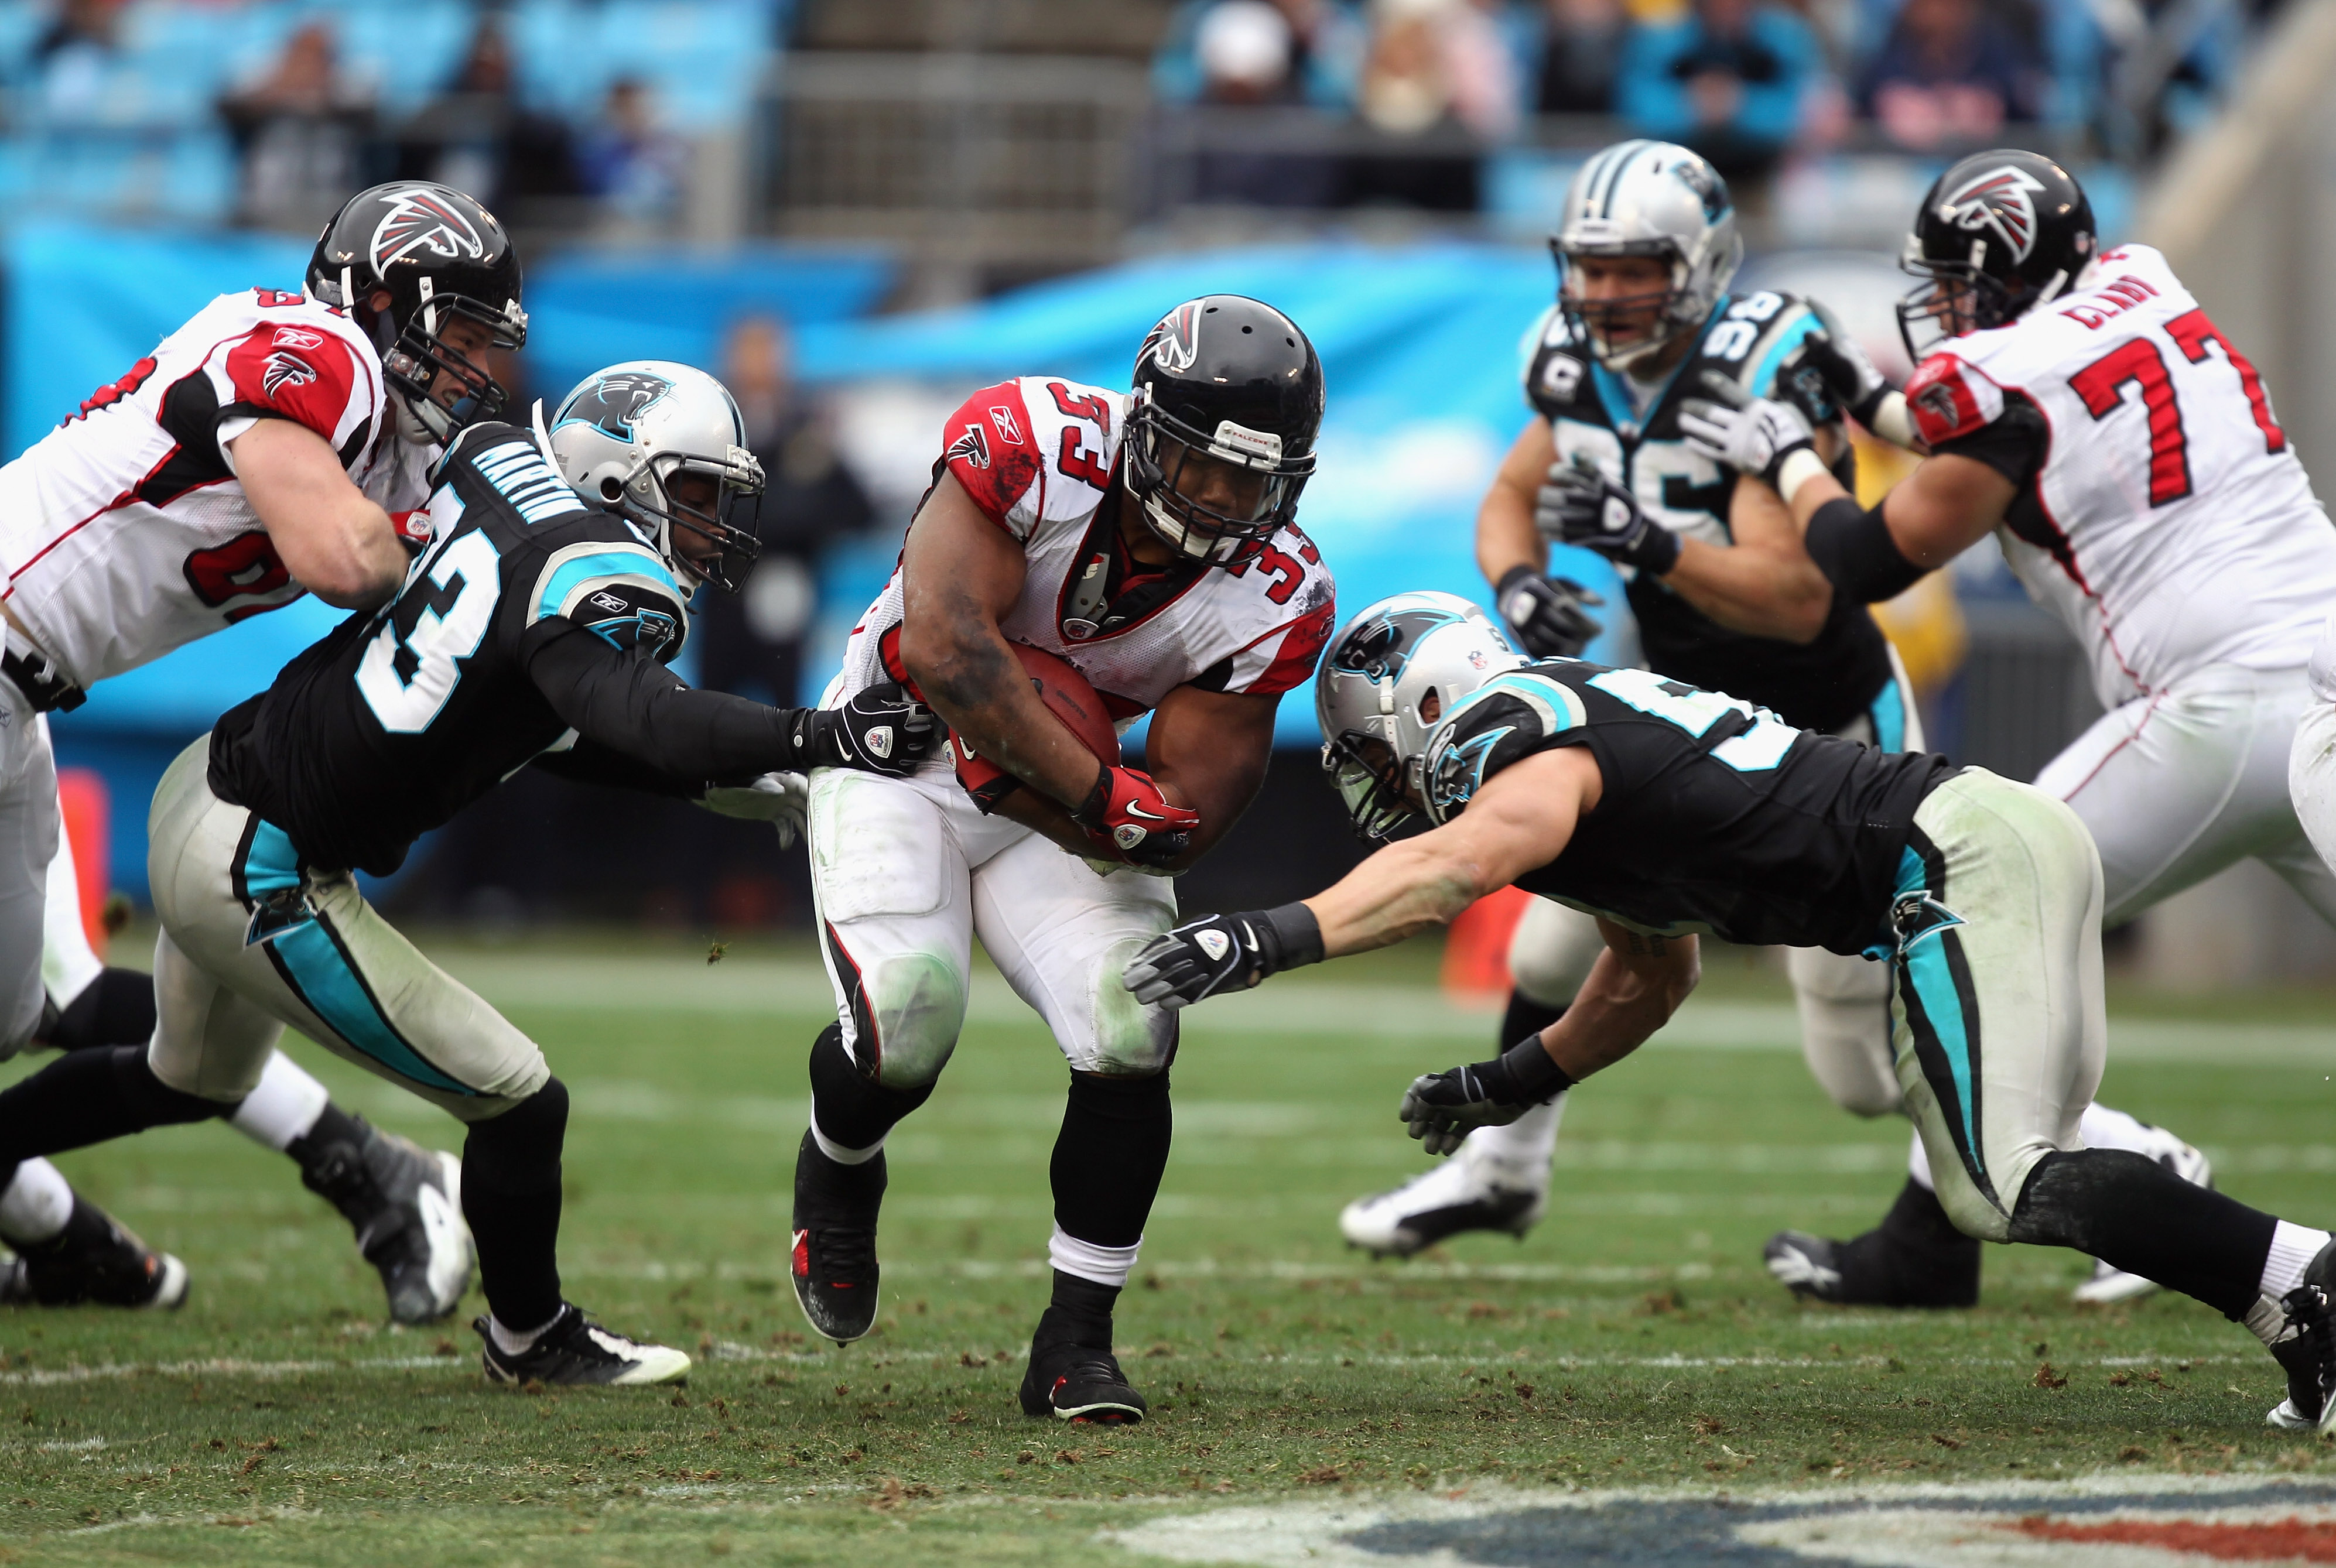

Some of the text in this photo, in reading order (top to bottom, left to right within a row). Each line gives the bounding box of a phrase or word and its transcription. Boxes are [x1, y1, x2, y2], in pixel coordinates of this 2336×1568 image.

[1046, 382, 1110, 492] 33
[1233, 432, 1268, 445] FALCONS
[2067, 307, 2286, 508] 77
[471, 441, 589, 525] MARTIN
